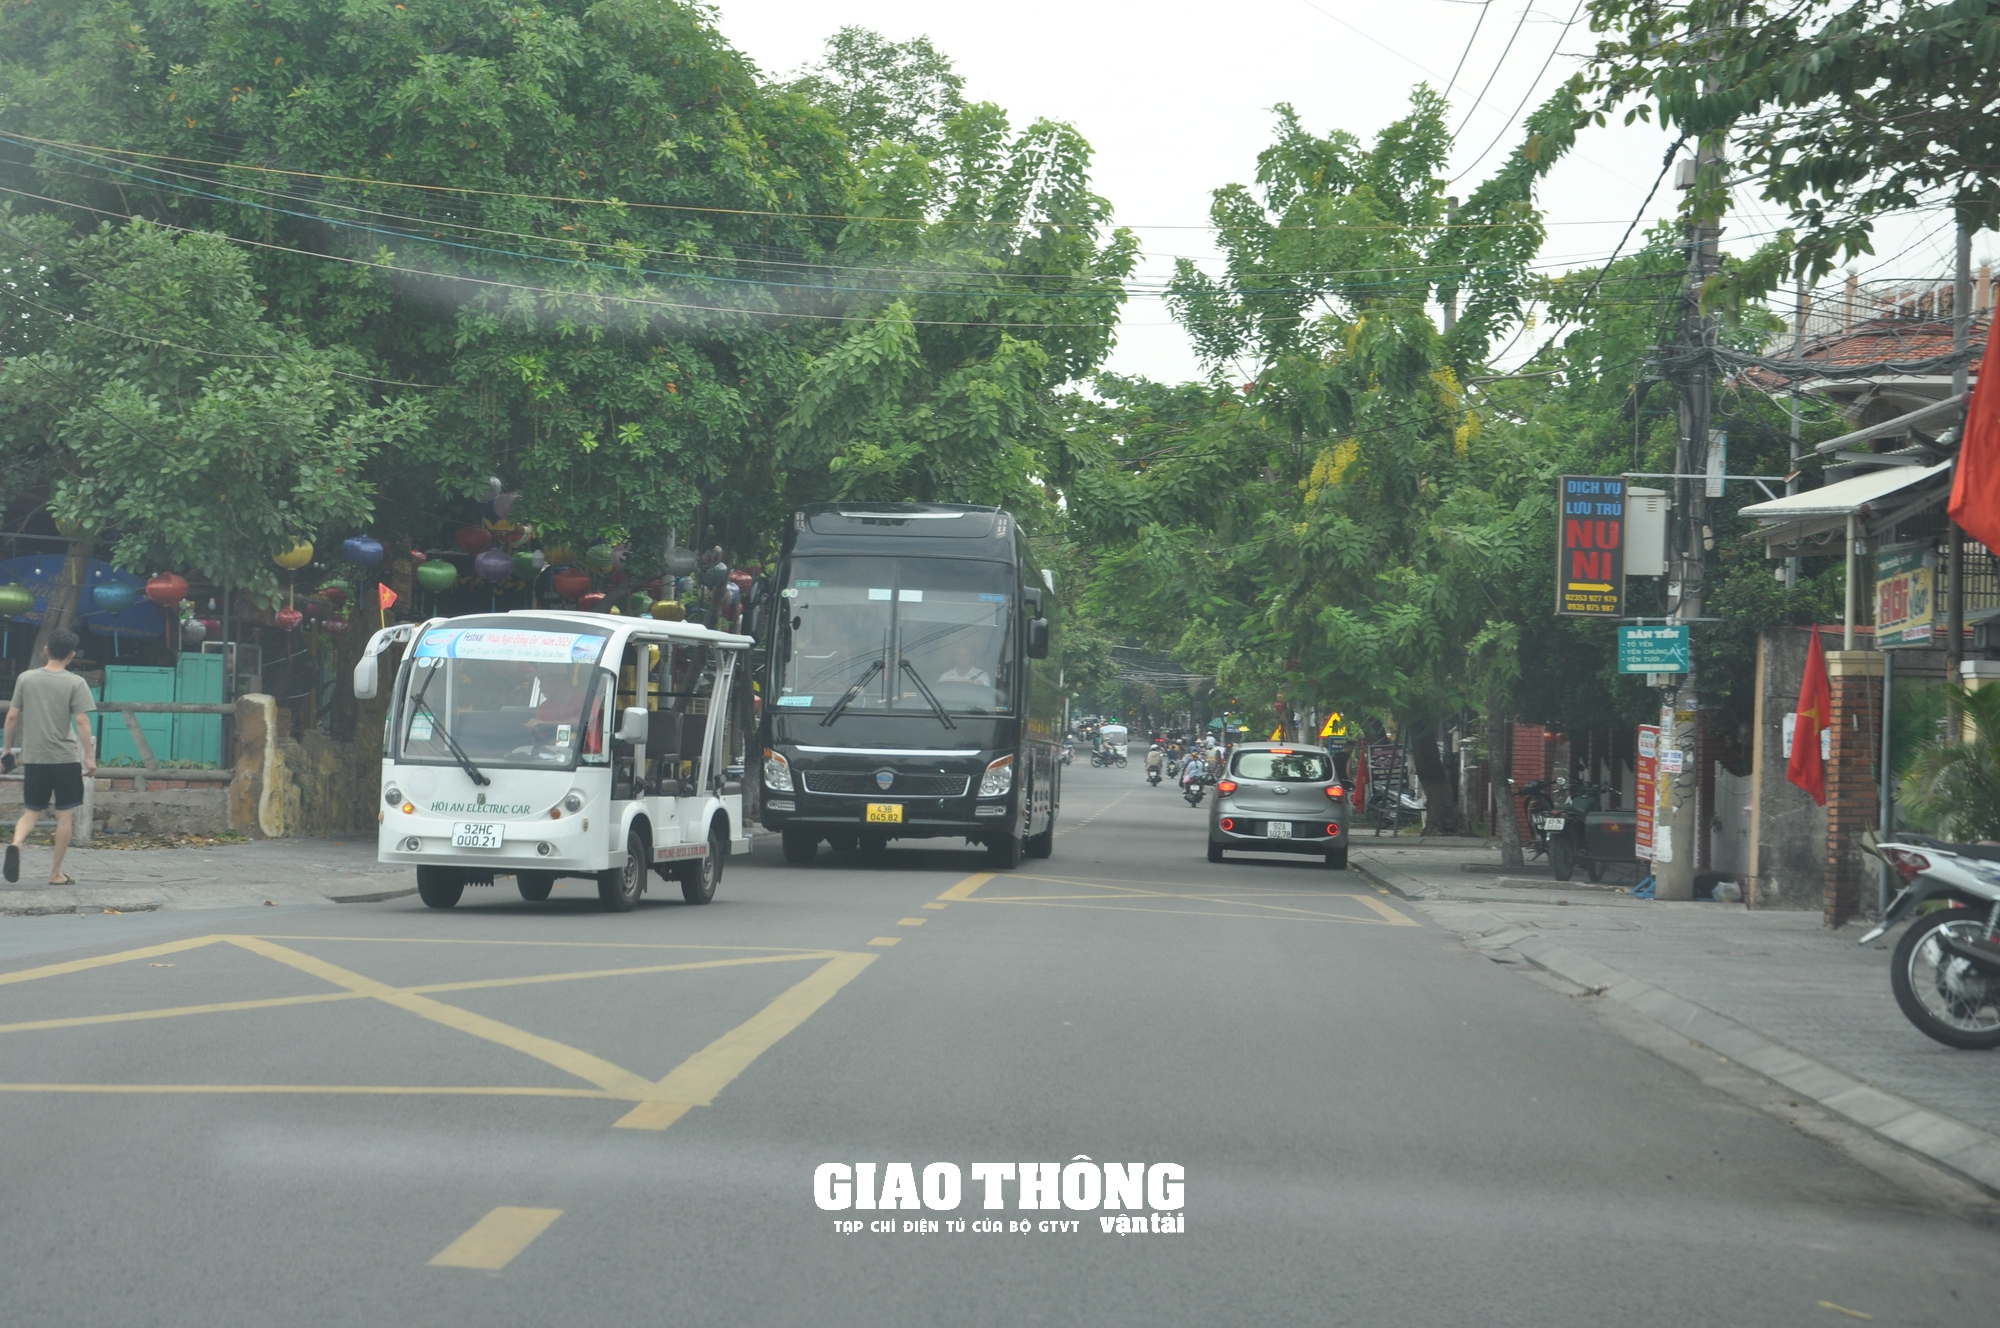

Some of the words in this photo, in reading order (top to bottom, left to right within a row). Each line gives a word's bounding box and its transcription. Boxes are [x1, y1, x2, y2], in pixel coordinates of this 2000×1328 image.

[1568, 481, 1600, 496] DỊCH
[1603, 482, 1622, 497] VỤ
[1566, 501, 1592, 515] LƯU
[1595, 501, 1622, 516] TRÚ
[1566, 519, 1619, 550] NU
[1572, 550, 1612, 580] NI
[463, 632, 485, 642] Festival
[555, 636, 573, 647] 2023
[1627, 629, 1653, 639] BÁN
[450, 803, 465, 812] AN
[466, 803, 509, 814] ELECTRIC
[511, 804, 531, 814] CAR
[877, 805, 892, 813] 43B
[870, 813, 899, 822] 045.82
[464, 824, 493, 835] 92HC
[1273, 822, 1286, 830] 92A
[457, 835, 496, 847] 000.21
